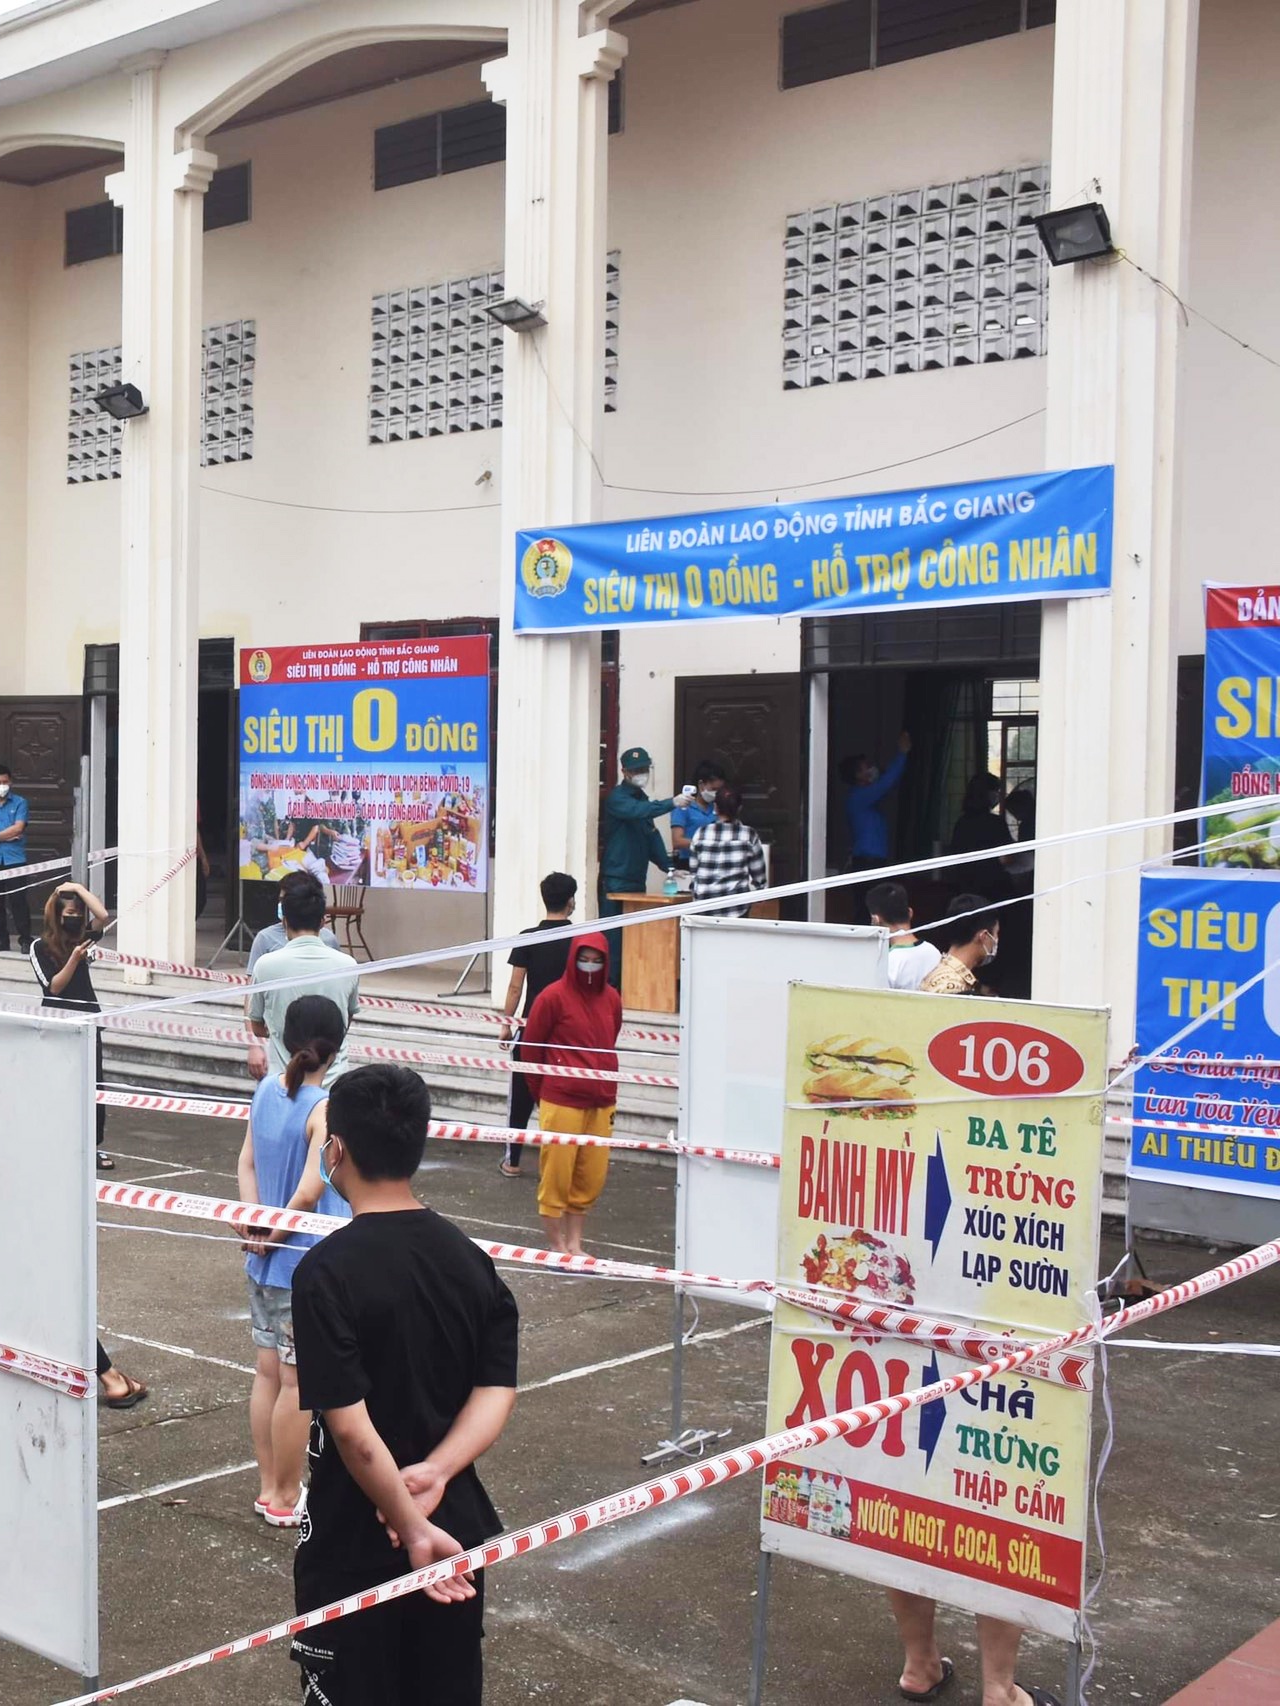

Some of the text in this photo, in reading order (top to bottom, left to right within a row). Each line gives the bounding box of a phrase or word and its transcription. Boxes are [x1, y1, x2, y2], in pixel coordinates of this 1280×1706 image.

[625, 490, 1036, 554] LIÊN ĐOÀN LAO ĐỘNG TỈNH BẮC GIANG
[582, 569, 636, 615] SIÊU
[643, 571, 680, 618] THỊ
[708, 553, 778, 606] ĐỒNG
[811, 541, 849, 599] HỖ
[855, 547, 911, 601] TRỢ
[918, 537, 1000, 590] CÔNG
[1008, 525, 1098, 582] NHÂN
[286, 662, 307, 679] SIÊU
[308, 663, 323, 680] THỊ
[331, 659, 357, 677] ĐỒNG
[381, 659, 401, 677] TRỢ
[401, 657, 428, 674] CÔNG
[430, 655, 458, 673] NHÂN
[340, 648, 354, 658] LAO
[414, 644, 440, 655] GIANG
[242, 707, 298, 755] SIÊU
[304, 714, 344, 762] THỊ
[405, 714, 479, 752] ĐỒNG
[1231, 763, 1271, 798] ĐỒNG
[1147, 901, 1259, 953] SIÊU
[1161, 976, 1238, 1031] THỊ
[957, 1033, 1051, 1088] 106
[967, 1115, 1058, 1158] BA TÊ
[1140, 1132, 1168, 1157] AI
[1176, 1134, 1257, 1169] THIẾU
[797, 1119, 916, 1237] BÁNH MỲ
[965, 1162, 1077, 1210] TRỨNG
[963, 1204, 1066, 1253] XÚC XÍCH
[961, 1250, 1069, 1298] LẠP SƯỜN
[959, 1379, 1035, 1420] CHẢ
[955, 1423, 1061, 1477] TRỨNG
[952, 1469, 1066, 1526] THẬP CẨM
[856, 1493, 900, 1541] NƯỚC
[902, 1509, 949, 1558] NGỌT,
[953, 1522, 1003, 1575] COCA,
